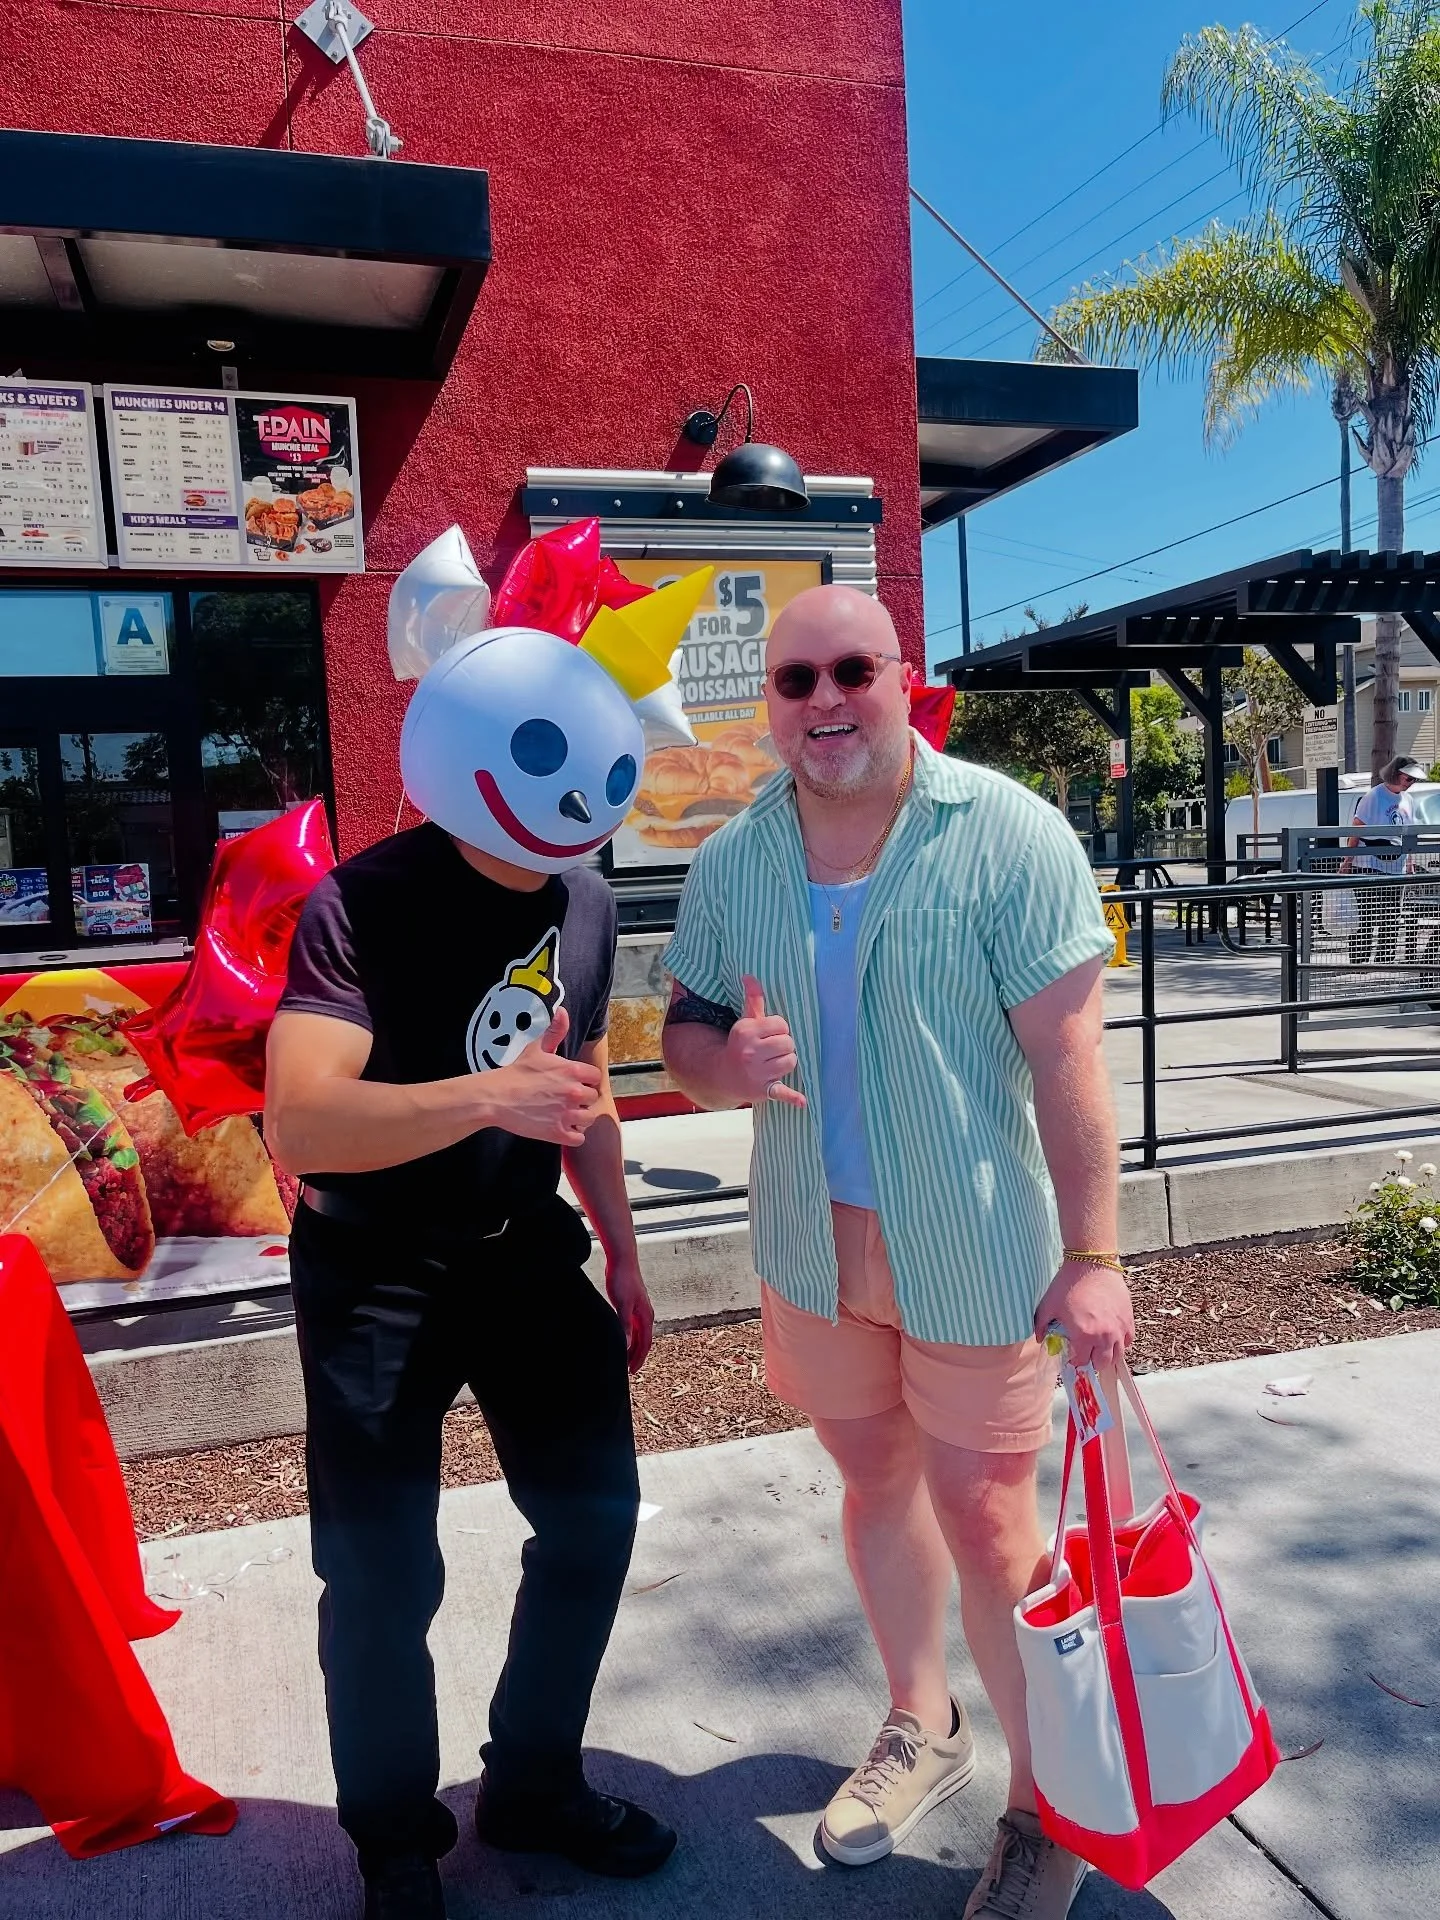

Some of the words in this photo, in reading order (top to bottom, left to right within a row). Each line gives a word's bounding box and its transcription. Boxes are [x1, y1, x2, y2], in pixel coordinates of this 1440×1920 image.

[17, 393, 27, 404] &
[28, 394, 78, 407] SWEETS
[114, 396, 172, 409] MUNCHIES
[174, 399, 212, 411] UNDER
[214, 401, 226, 412] $4
[271, 442, 301, 452] MUNCHIE
[301, 443, 319, 452] MEAL
[130, 515, 155, 524] KID'S
[155, 516, 187, 525] MEALS
[116, 607, 155, 645] A
[698, 615, 732, 637] FOR
[680, 641, 767, 679] AUSAG
[725, 709, 740, 721] ALL
[740, 707, 755, 719] DAY
[1314, 709, 1325, 719] NO
[92, 890, 110, 898] BOX
